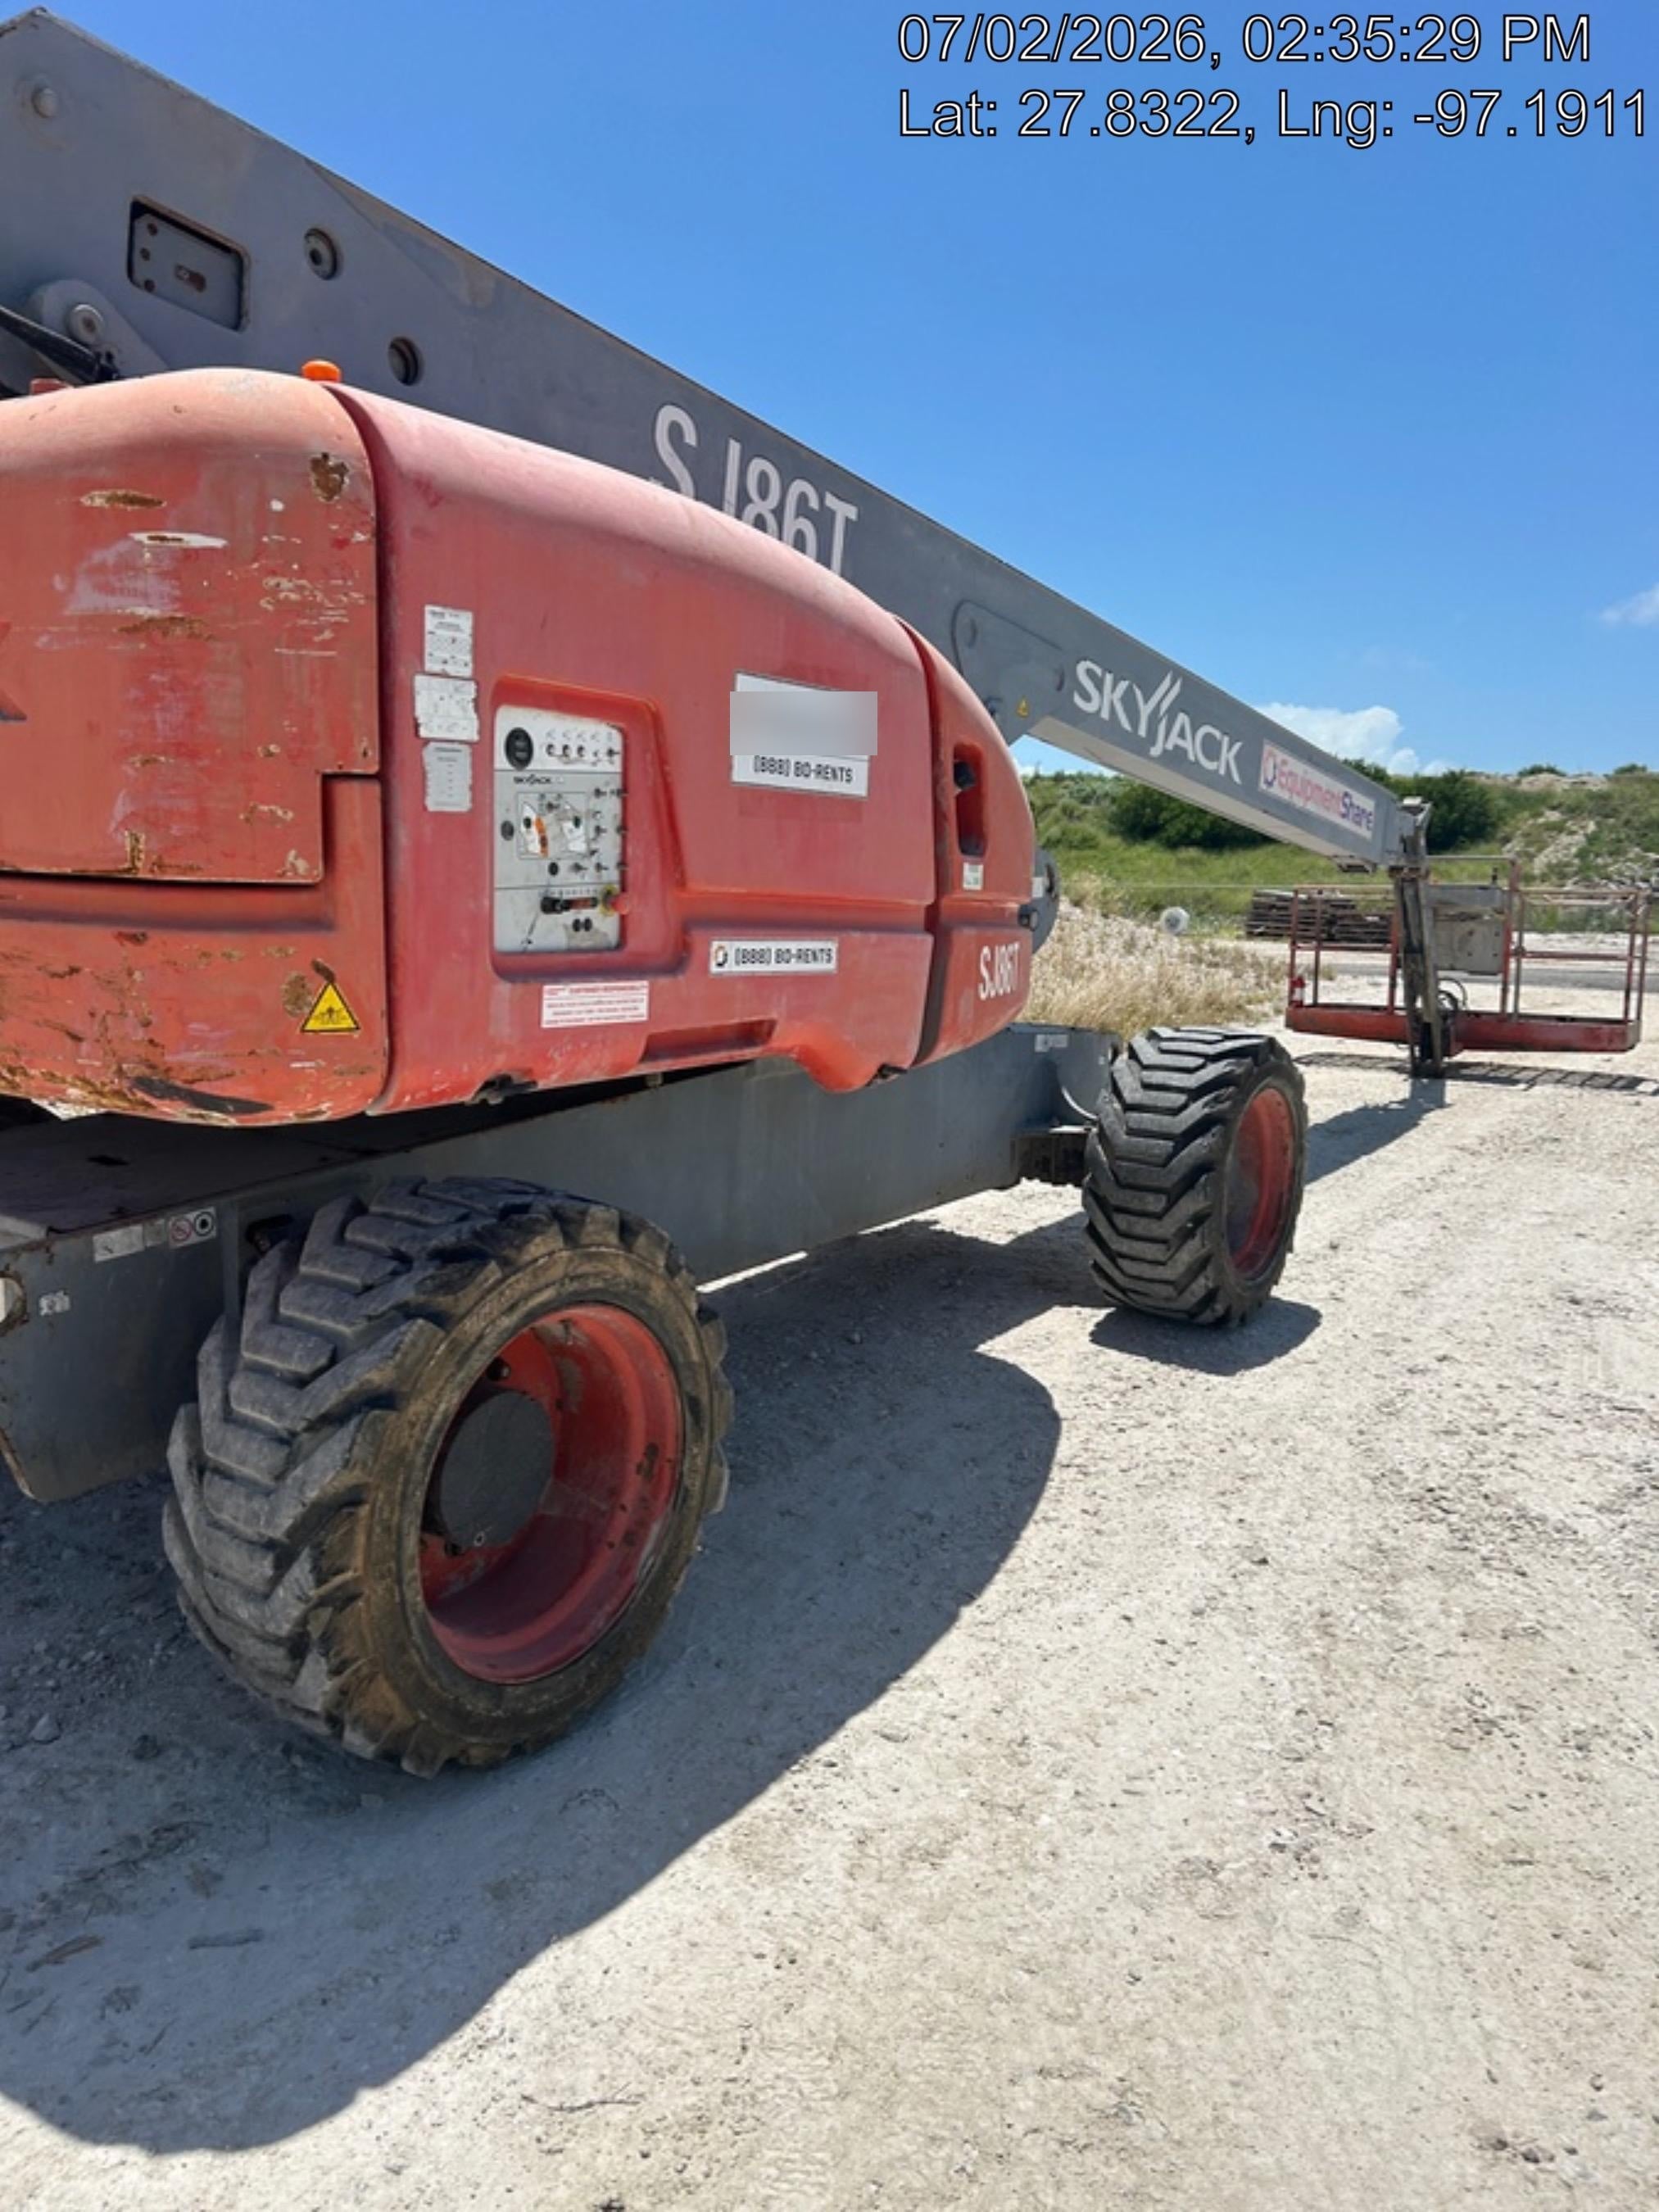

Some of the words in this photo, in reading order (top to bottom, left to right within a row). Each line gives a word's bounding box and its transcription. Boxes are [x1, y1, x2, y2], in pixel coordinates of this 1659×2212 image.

[1073, 660, 1244, 786] SKYJACK
[1277, 759, 1374, 832] EquipmentShare
[978, 941, 1021, 1000] SJ86T
